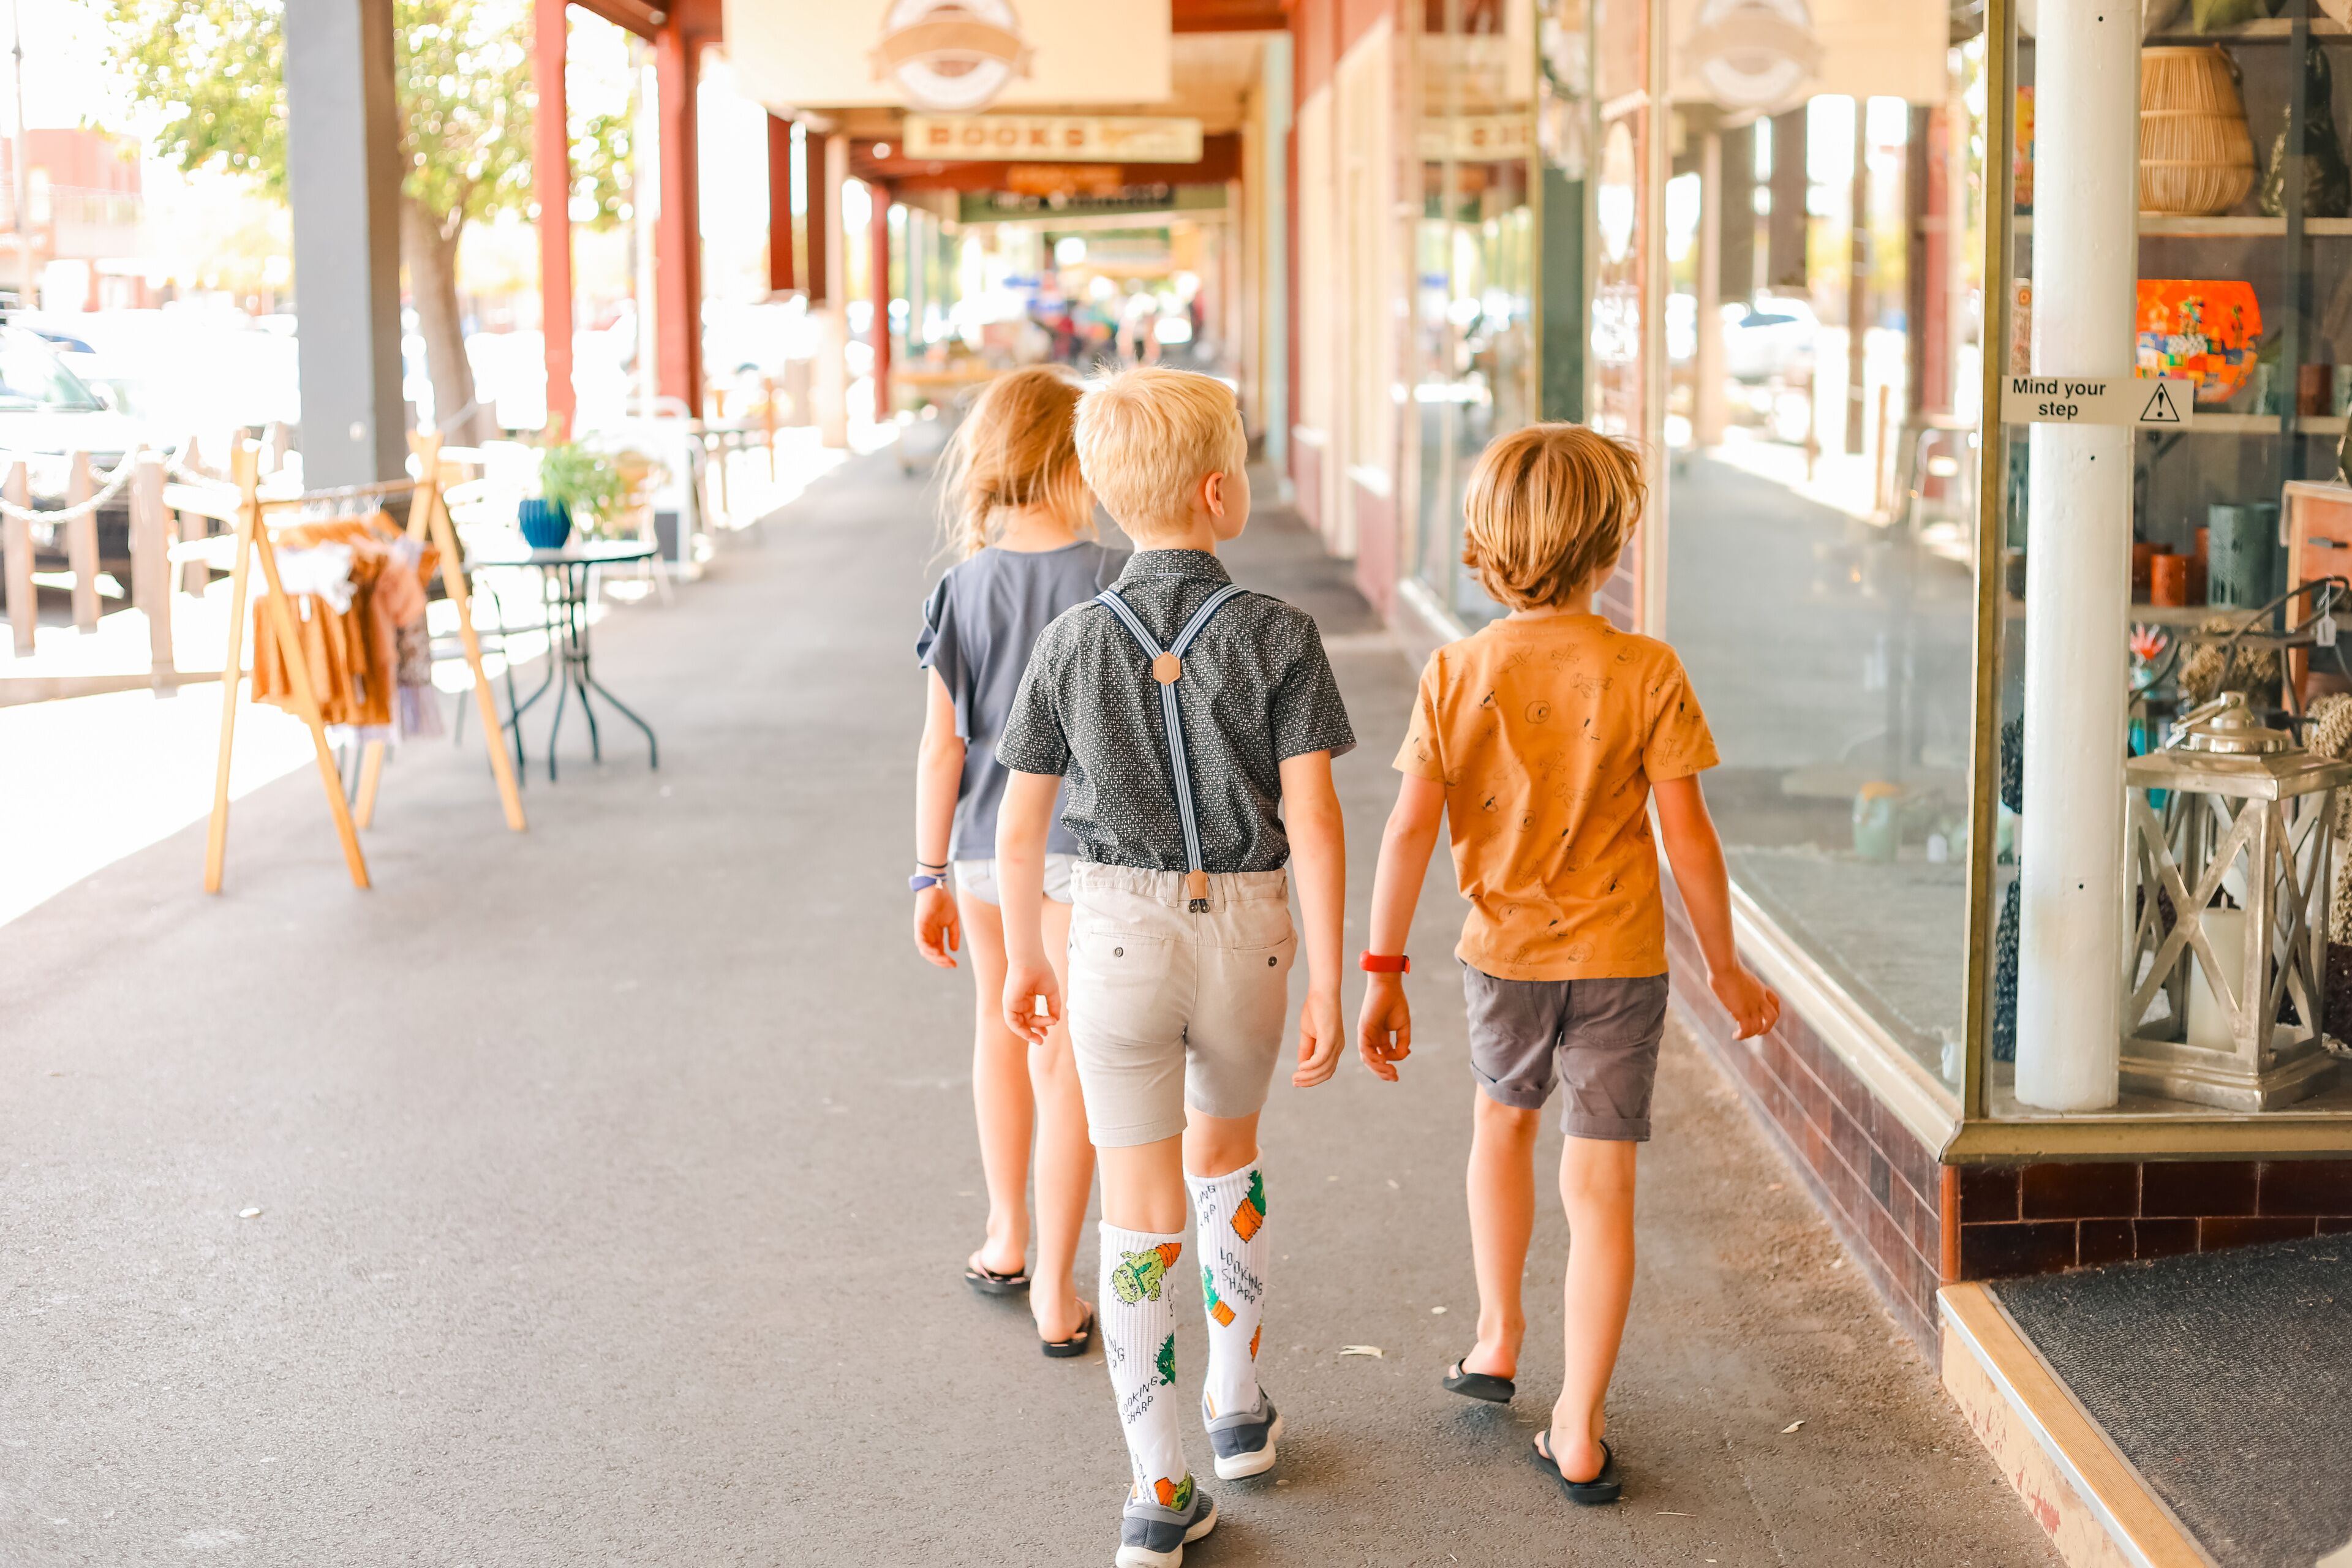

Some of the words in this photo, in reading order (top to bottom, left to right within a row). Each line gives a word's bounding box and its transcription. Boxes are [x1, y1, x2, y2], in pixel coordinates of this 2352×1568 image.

[2013, 379, 2057, 394] Mind
[2065, 382, 2106, 398] your
[2038, 401, 2078, 420] step
[1220, 1246, 1263, 1295] LOOKING
[1221, 1268, 1256, 1305] SHARP
[1122, 1376, 1158, 1415] OOKING
[1126, 1396, 1153, 1424] SHARP
